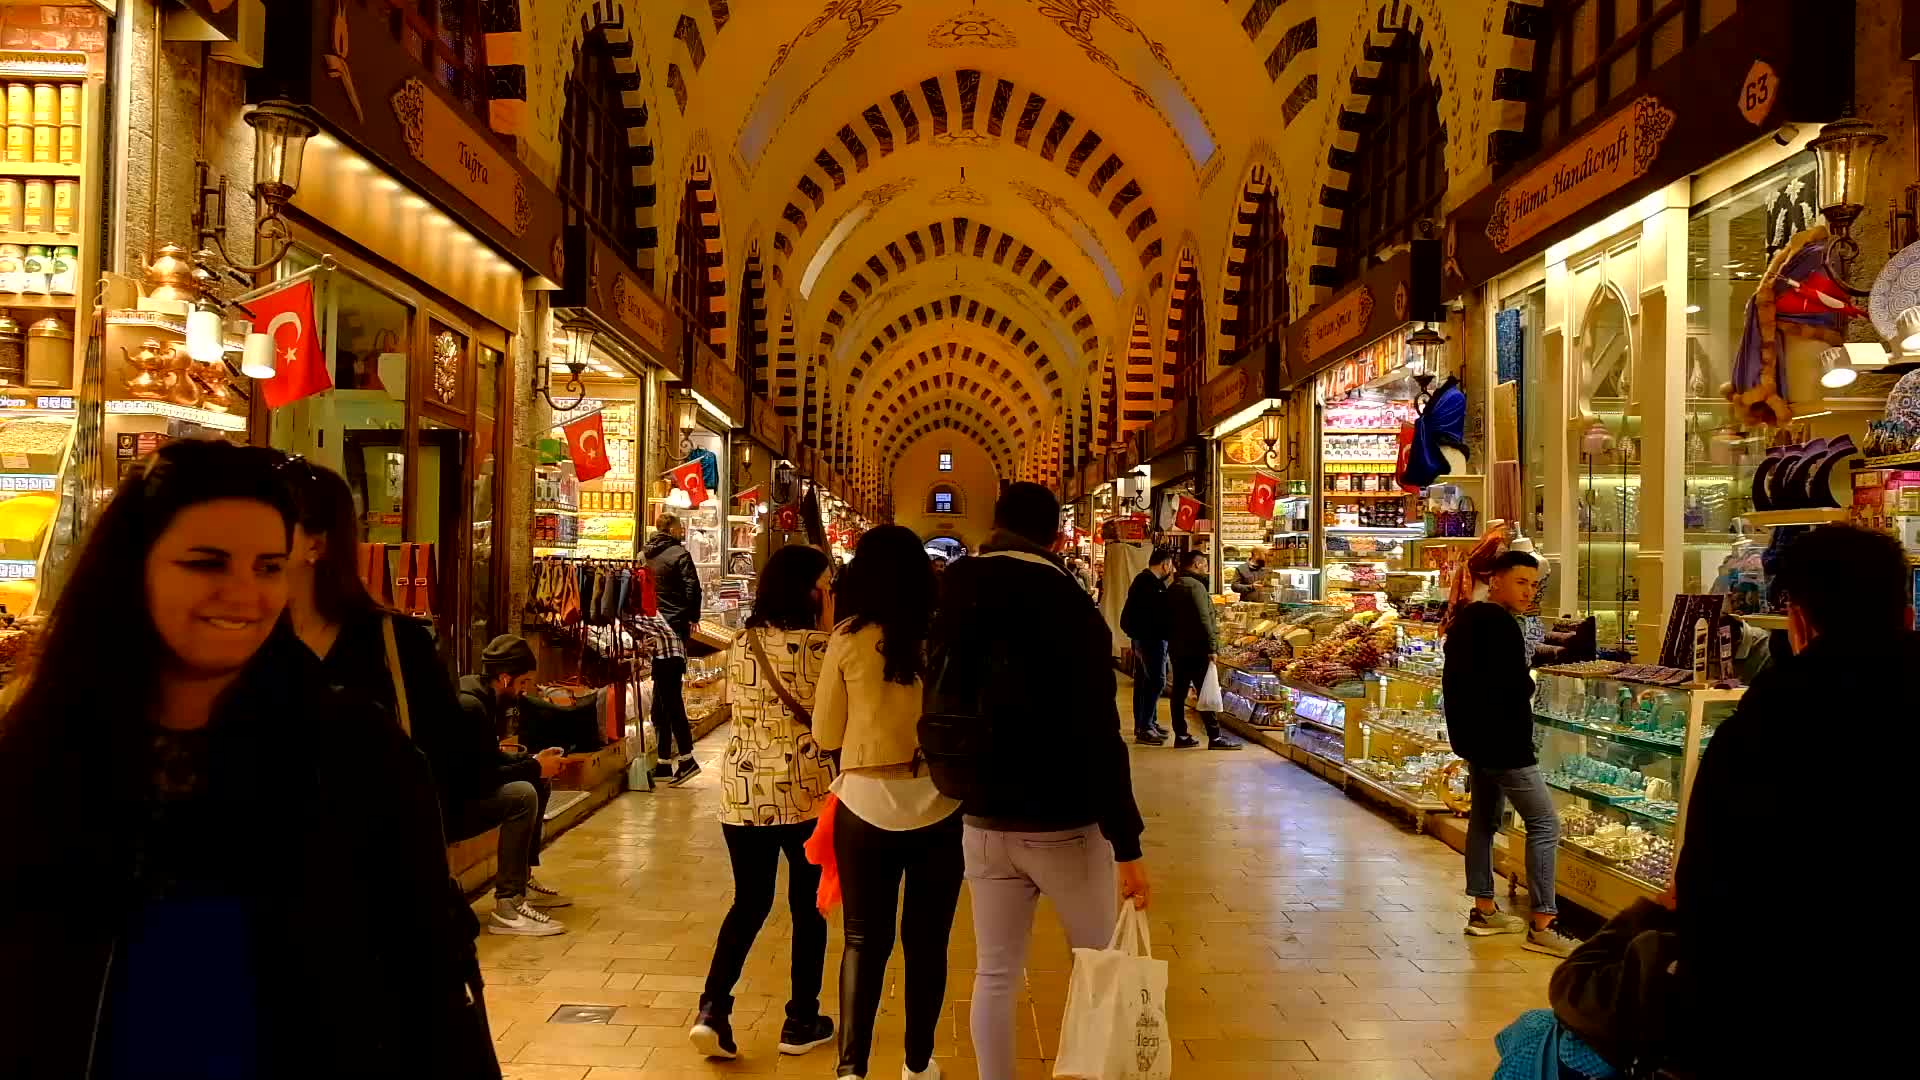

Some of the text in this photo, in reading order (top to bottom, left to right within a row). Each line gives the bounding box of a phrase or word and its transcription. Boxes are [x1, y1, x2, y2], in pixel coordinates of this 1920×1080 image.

[1746, 72, 1768, 111] 63
[457, 141, 488, 184] Tuğra
[1551, 125, 1628, 199] Handicraft
